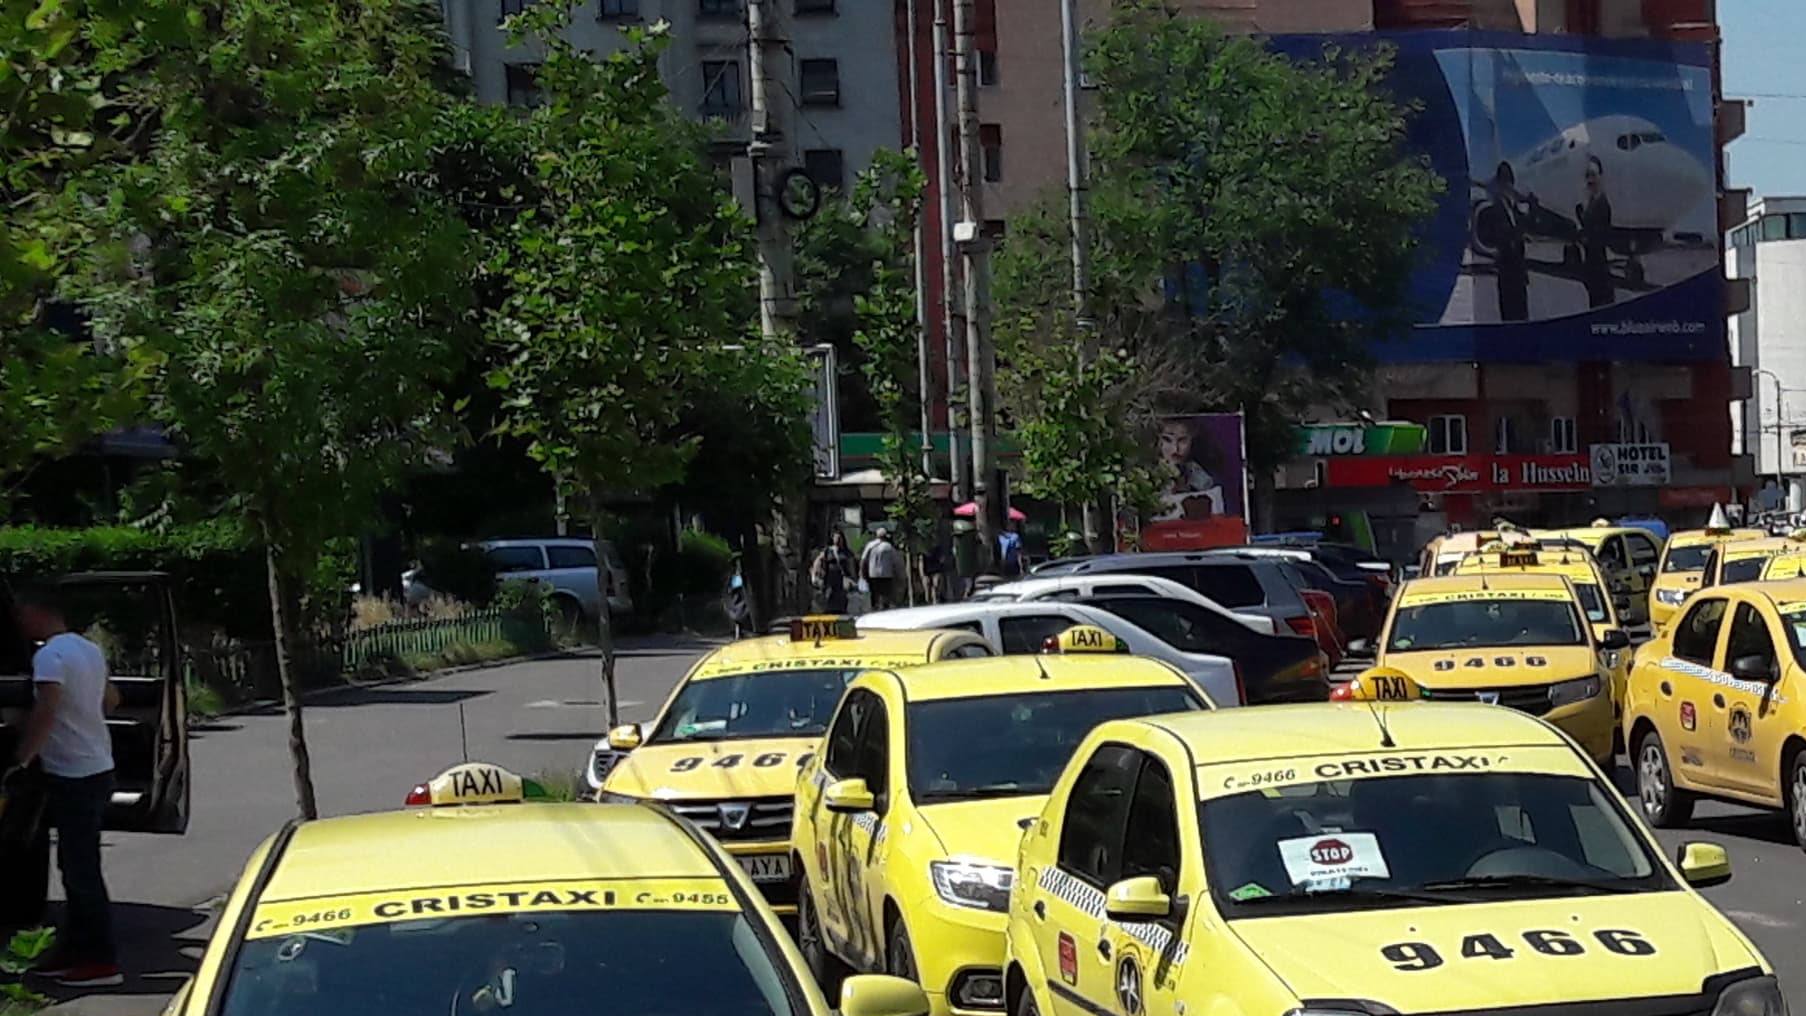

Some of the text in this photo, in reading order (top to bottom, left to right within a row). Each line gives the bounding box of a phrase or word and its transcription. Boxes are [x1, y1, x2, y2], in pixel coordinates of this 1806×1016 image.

[1307, 425, 1367, 455] MOL
[1617, 446, 1666, 461] HOTEL
[1521, 461, 1590, 484] Hussein
[803, 622, 838, 638] TAXI
[1071, 629, 1103, 647] TAXI
[752, 659, 863, 670] CRISTAXI
[1433, 656, 1547, 671] 9466
[1370, 676, 1406, 698] TAXI
[1314, 756, 1490, 777] CRISTAXI
[448, 768, 503, 797] TAXI
[1311, 847, 1351, 861] STOP
[293, 908, 351, 927] 9466
[373, 890, 616, 918] CRISTAXI
[1381, 929, 1656, 971] 9466
